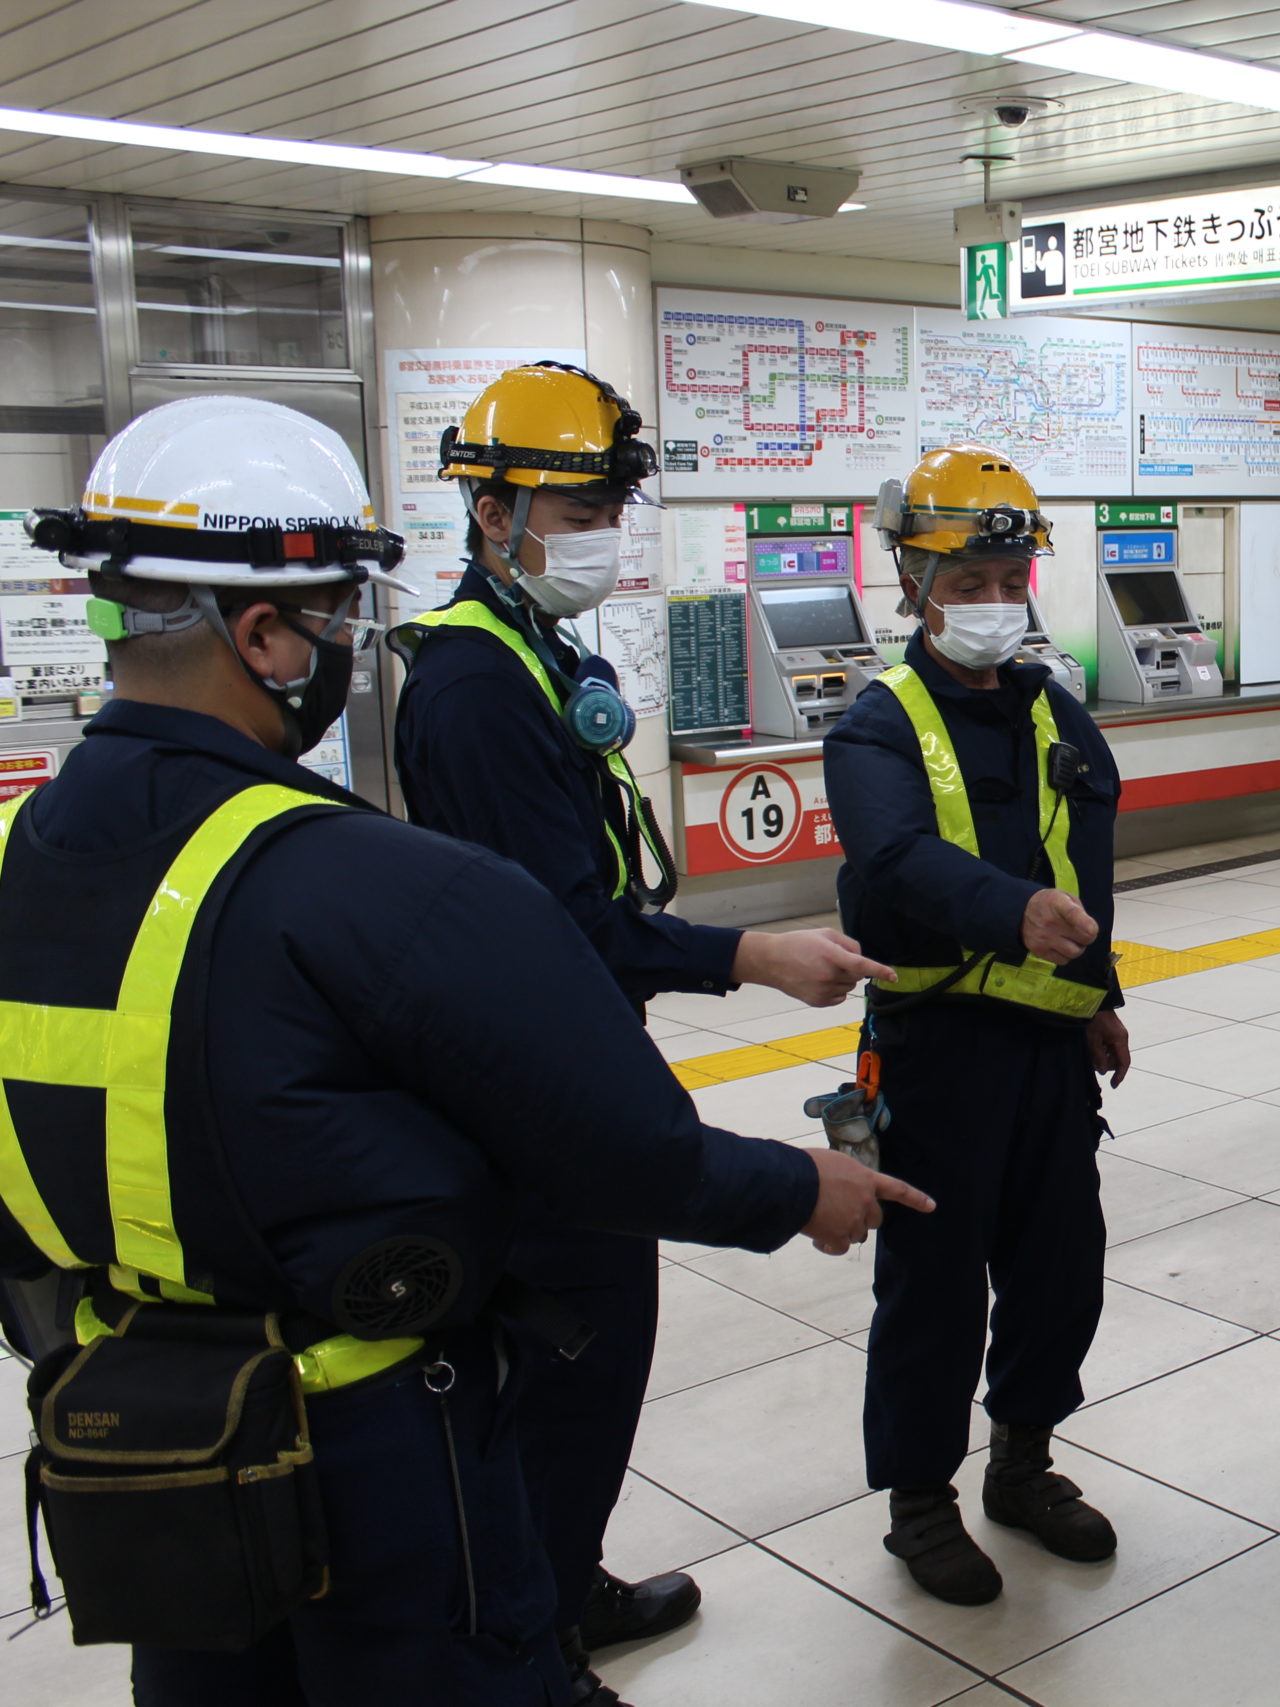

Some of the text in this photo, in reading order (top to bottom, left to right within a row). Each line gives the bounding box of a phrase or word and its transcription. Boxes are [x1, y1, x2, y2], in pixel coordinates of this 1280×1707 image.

[1073, 254, 1208, 280] TOEI SUBWAY Tickets
[203, 513, 279, 530] NIPPON
[749, 507, 759, 530] 1
[1099, 503, 1110, 523] 3
[15, 677, 102, 690] ご案内いたします
[750, 775, 771, 800] A
[741, 803, 784, 841] 19
[67, 1411, 120, 1427] DENSAN
